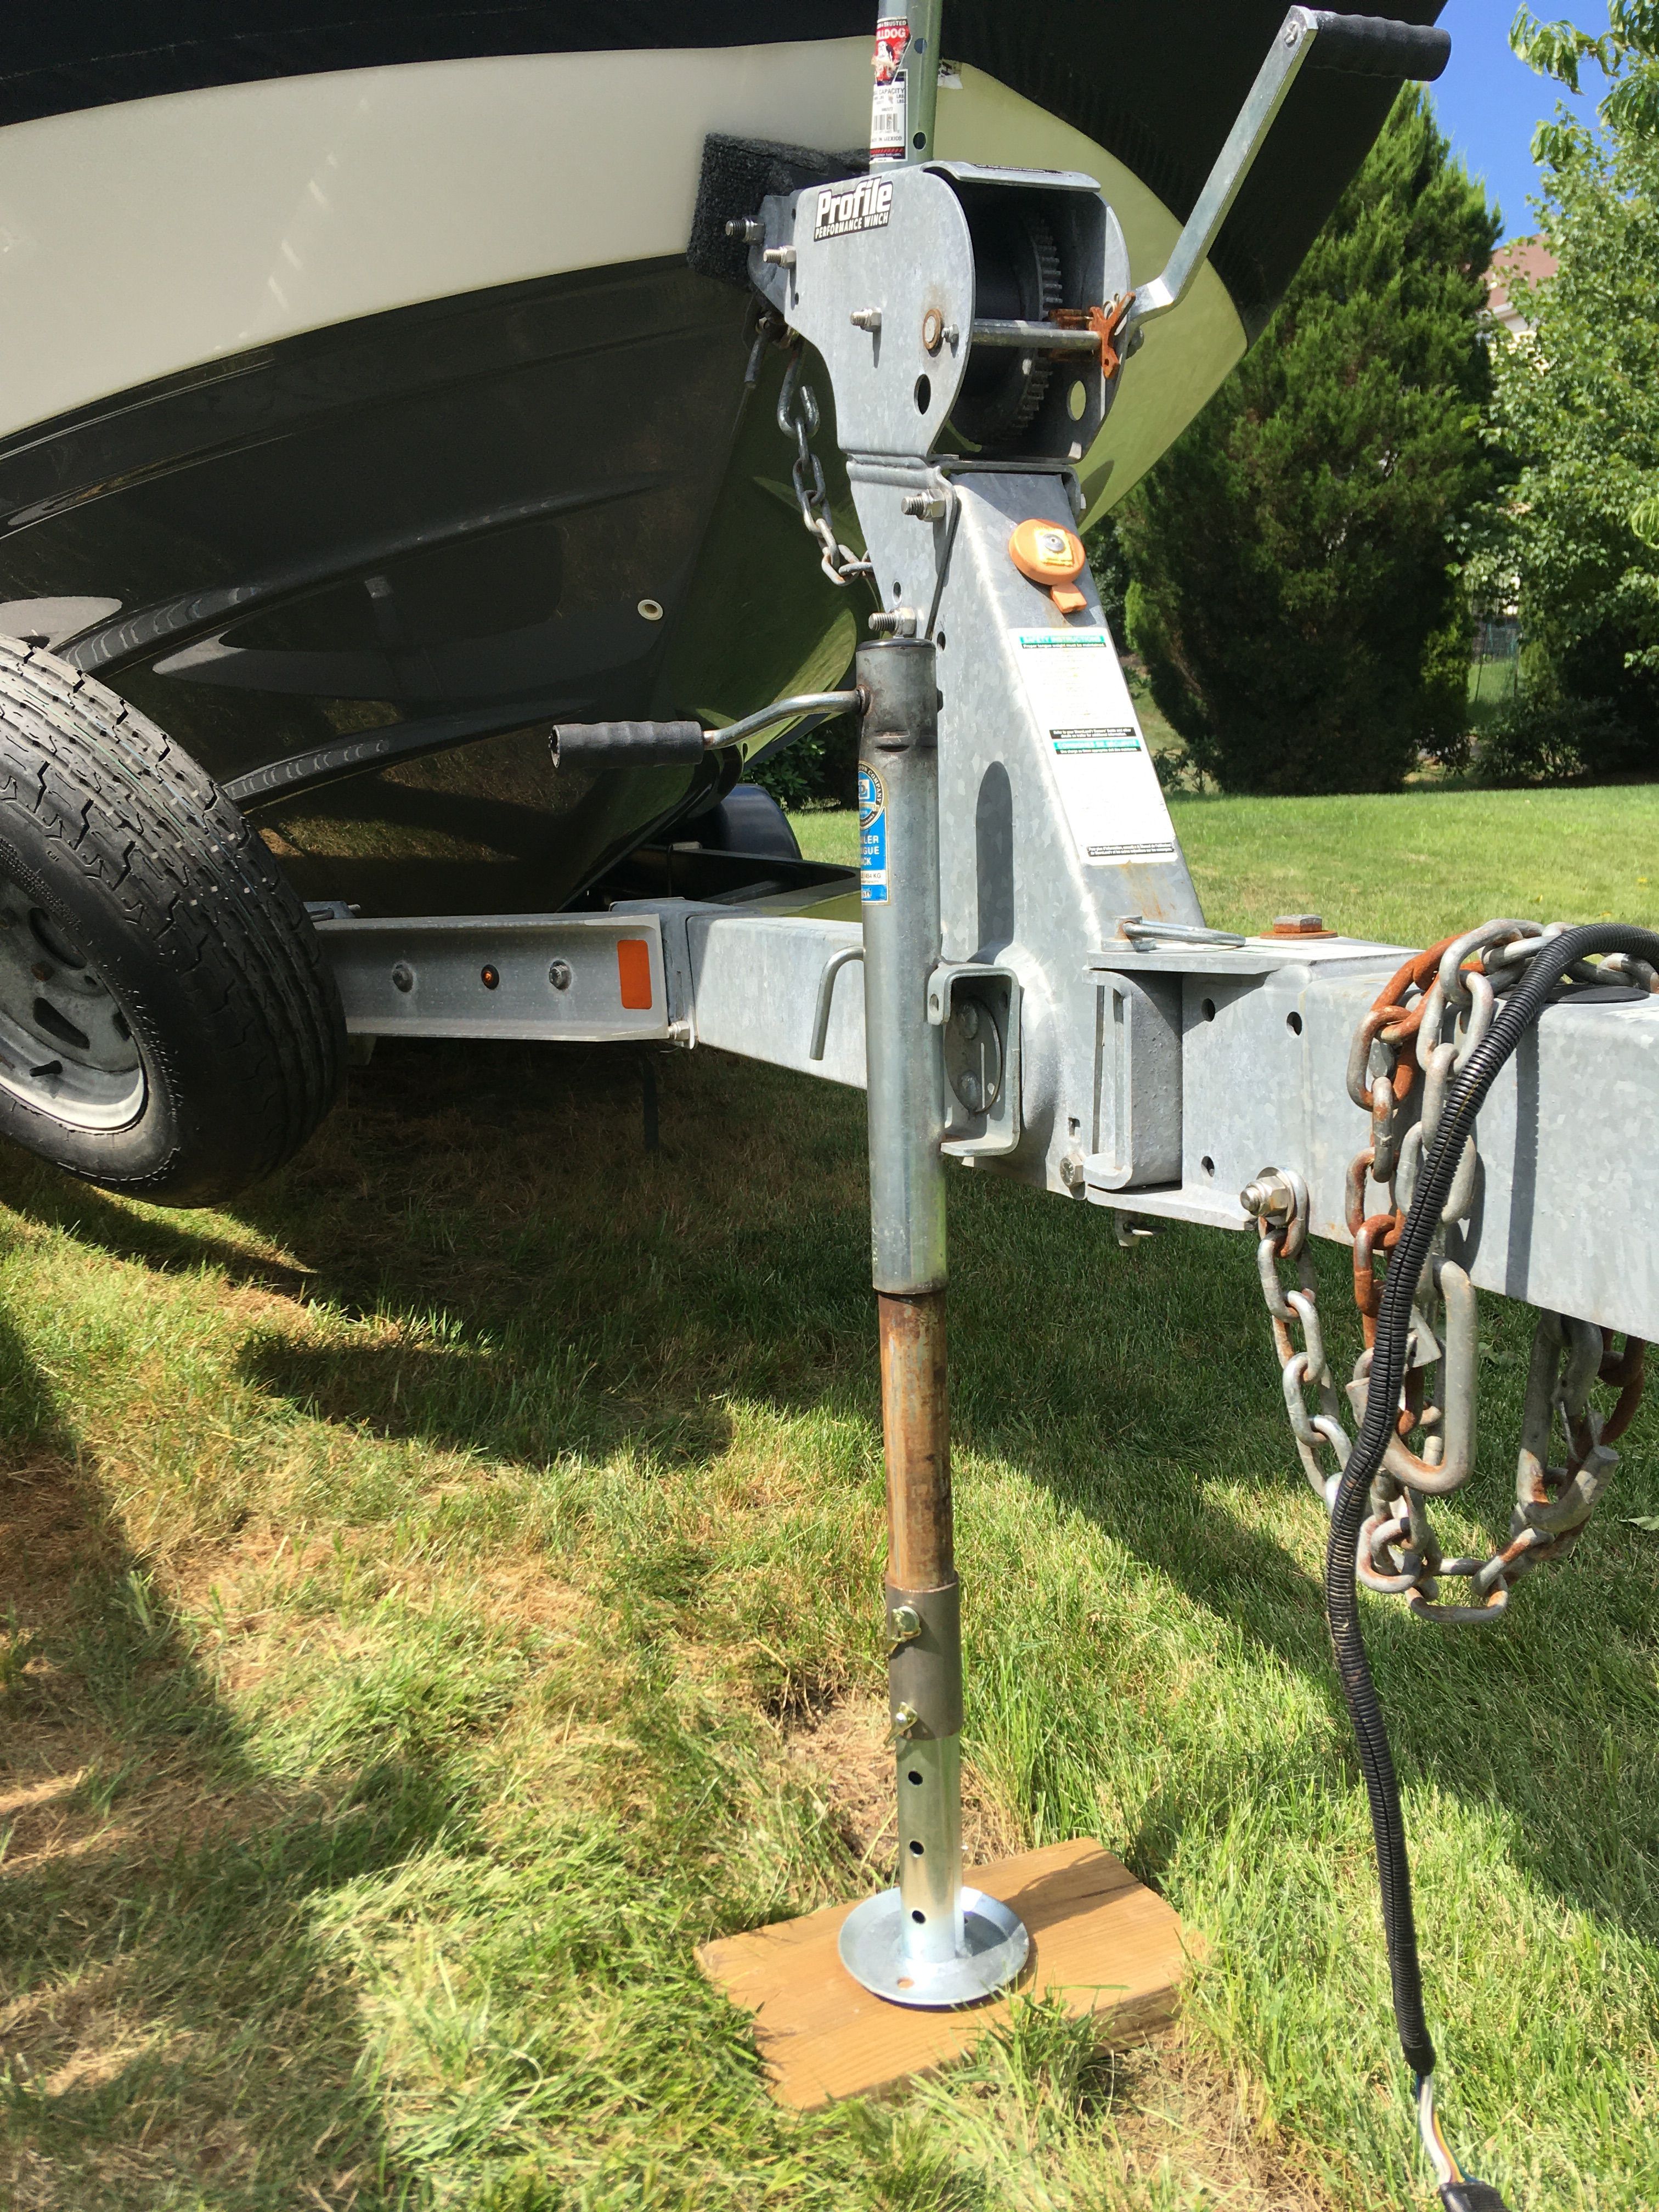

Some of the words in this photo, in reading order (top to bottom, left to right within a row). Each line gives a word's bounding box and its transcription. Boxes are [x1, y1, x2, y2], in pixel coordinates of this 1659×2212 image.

[877, 27, 906, 40] LLDOG
[815, 177, 893, 228] Profile
[815, 217, 863, 239] PERFORMANCE
[864, 212, 889, 228] WINCH
[868, 770, 882, 803] COMPANY
